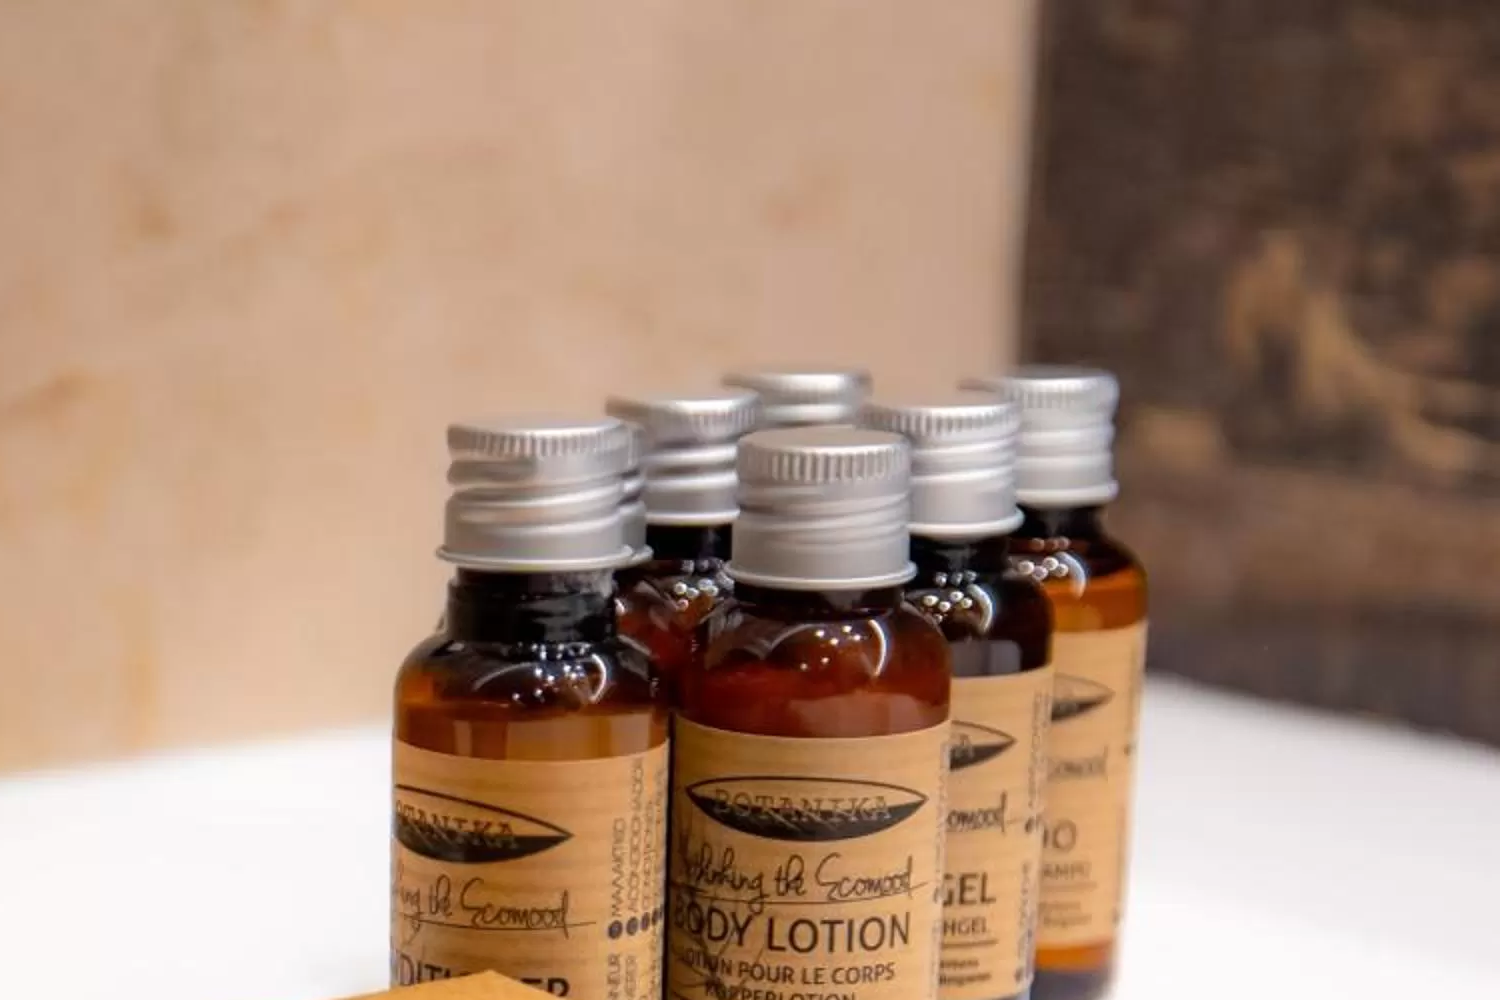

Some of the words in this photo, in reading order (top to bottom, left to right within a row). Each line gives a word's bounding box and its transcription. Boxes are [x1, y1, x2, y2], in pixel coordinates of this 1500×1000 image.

[713, 787, 893, 825] BOTANIKA
[774, 853, 807, 897] the
[674, 900, 754, 947] BODY
[767, 911, 911, 953] LOTION
[738, 960, 795, 985] POUR
[801, 967, 825, 985] LE
[831, 962, 896, 985] CORPS
